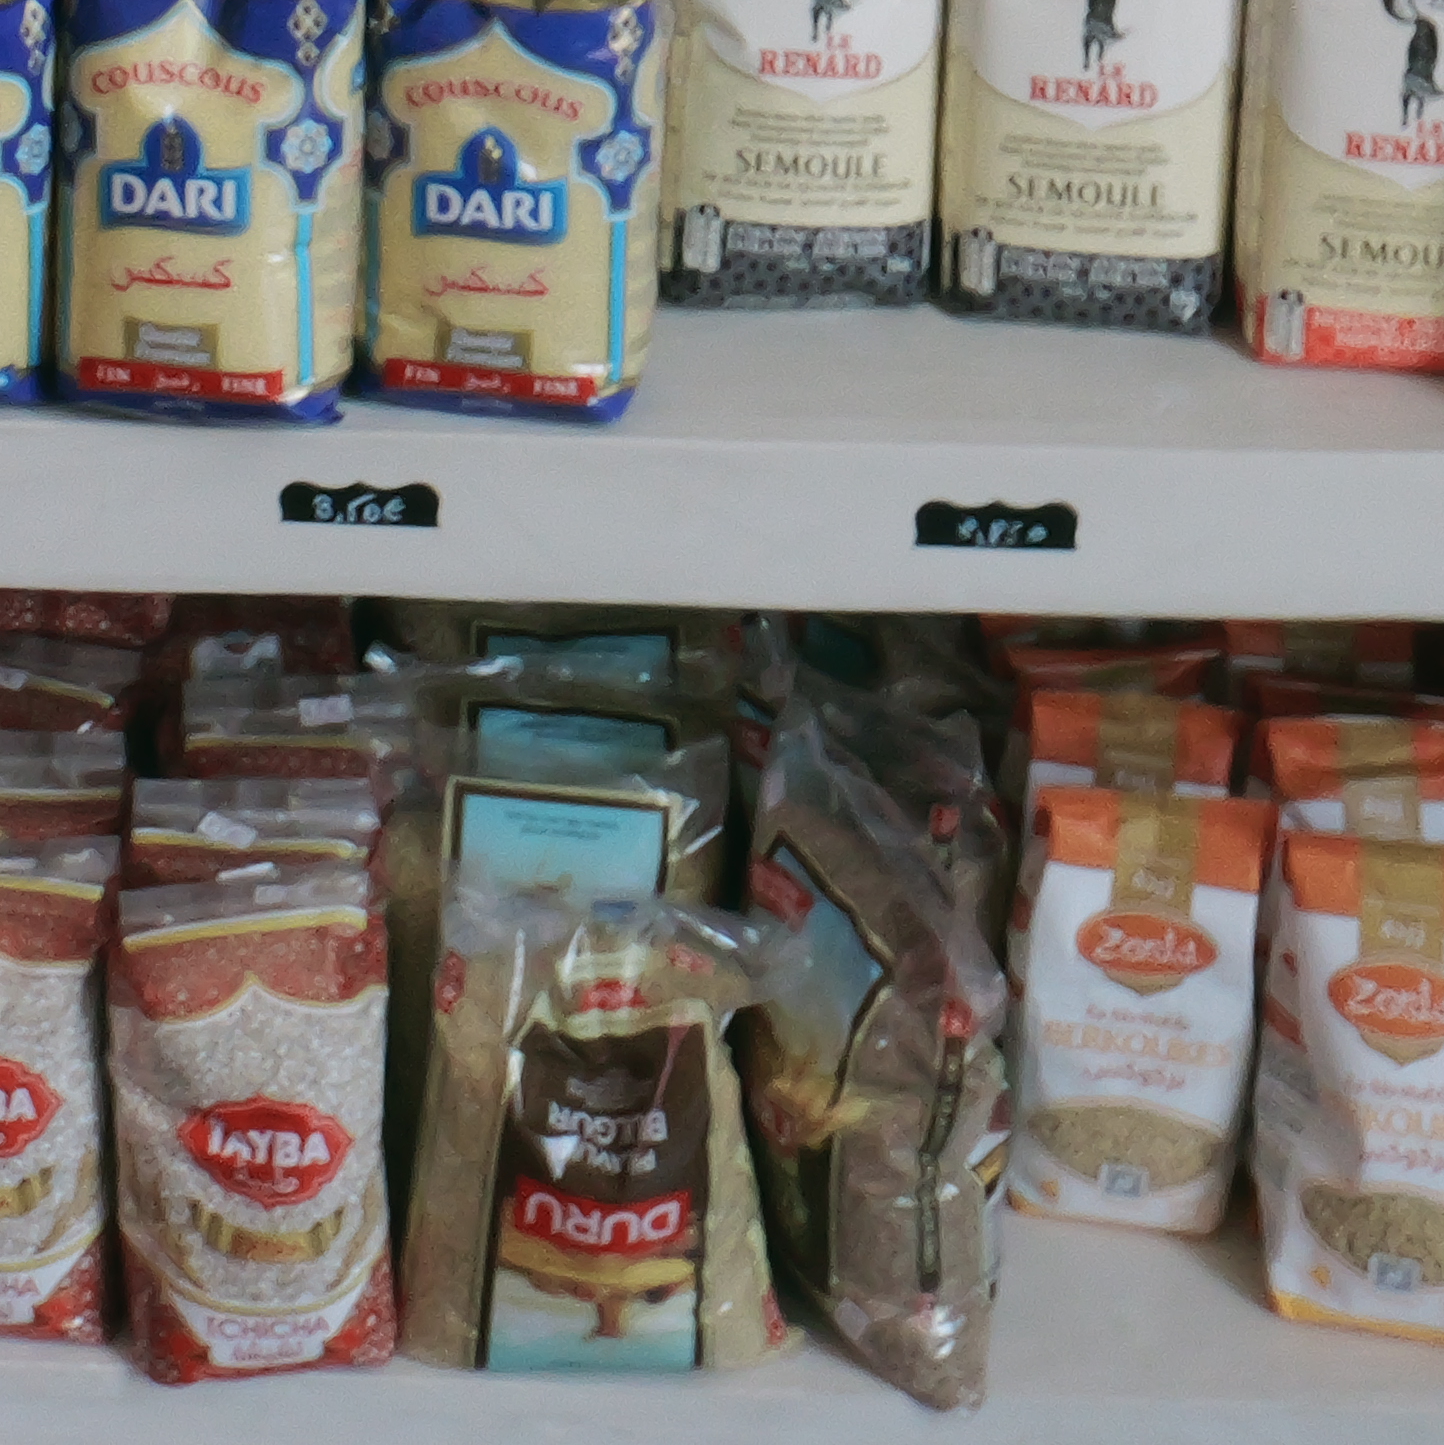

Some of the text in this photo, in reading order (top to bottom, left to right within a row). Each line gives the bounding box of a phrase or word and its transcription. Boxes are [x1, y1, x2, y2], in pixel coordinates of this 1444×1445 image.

[90, 58, 266, 106] COUSCOUS
[758, 50, 883, 81] RENARD
[404, 77, 585, 123] COUSCOUS
[1029, 75, 1159, 109] RENARD
[735, 148, 889, 179] SEMOULE
[112, 173, 240, 223] DARI
[425, 183, 555, 234] DARI
[1007, 172, 1165, 208] SEMOULE
[206, 1126, 330, 1170] TAYBA
[524, 1192, 682, 1247] DURU
